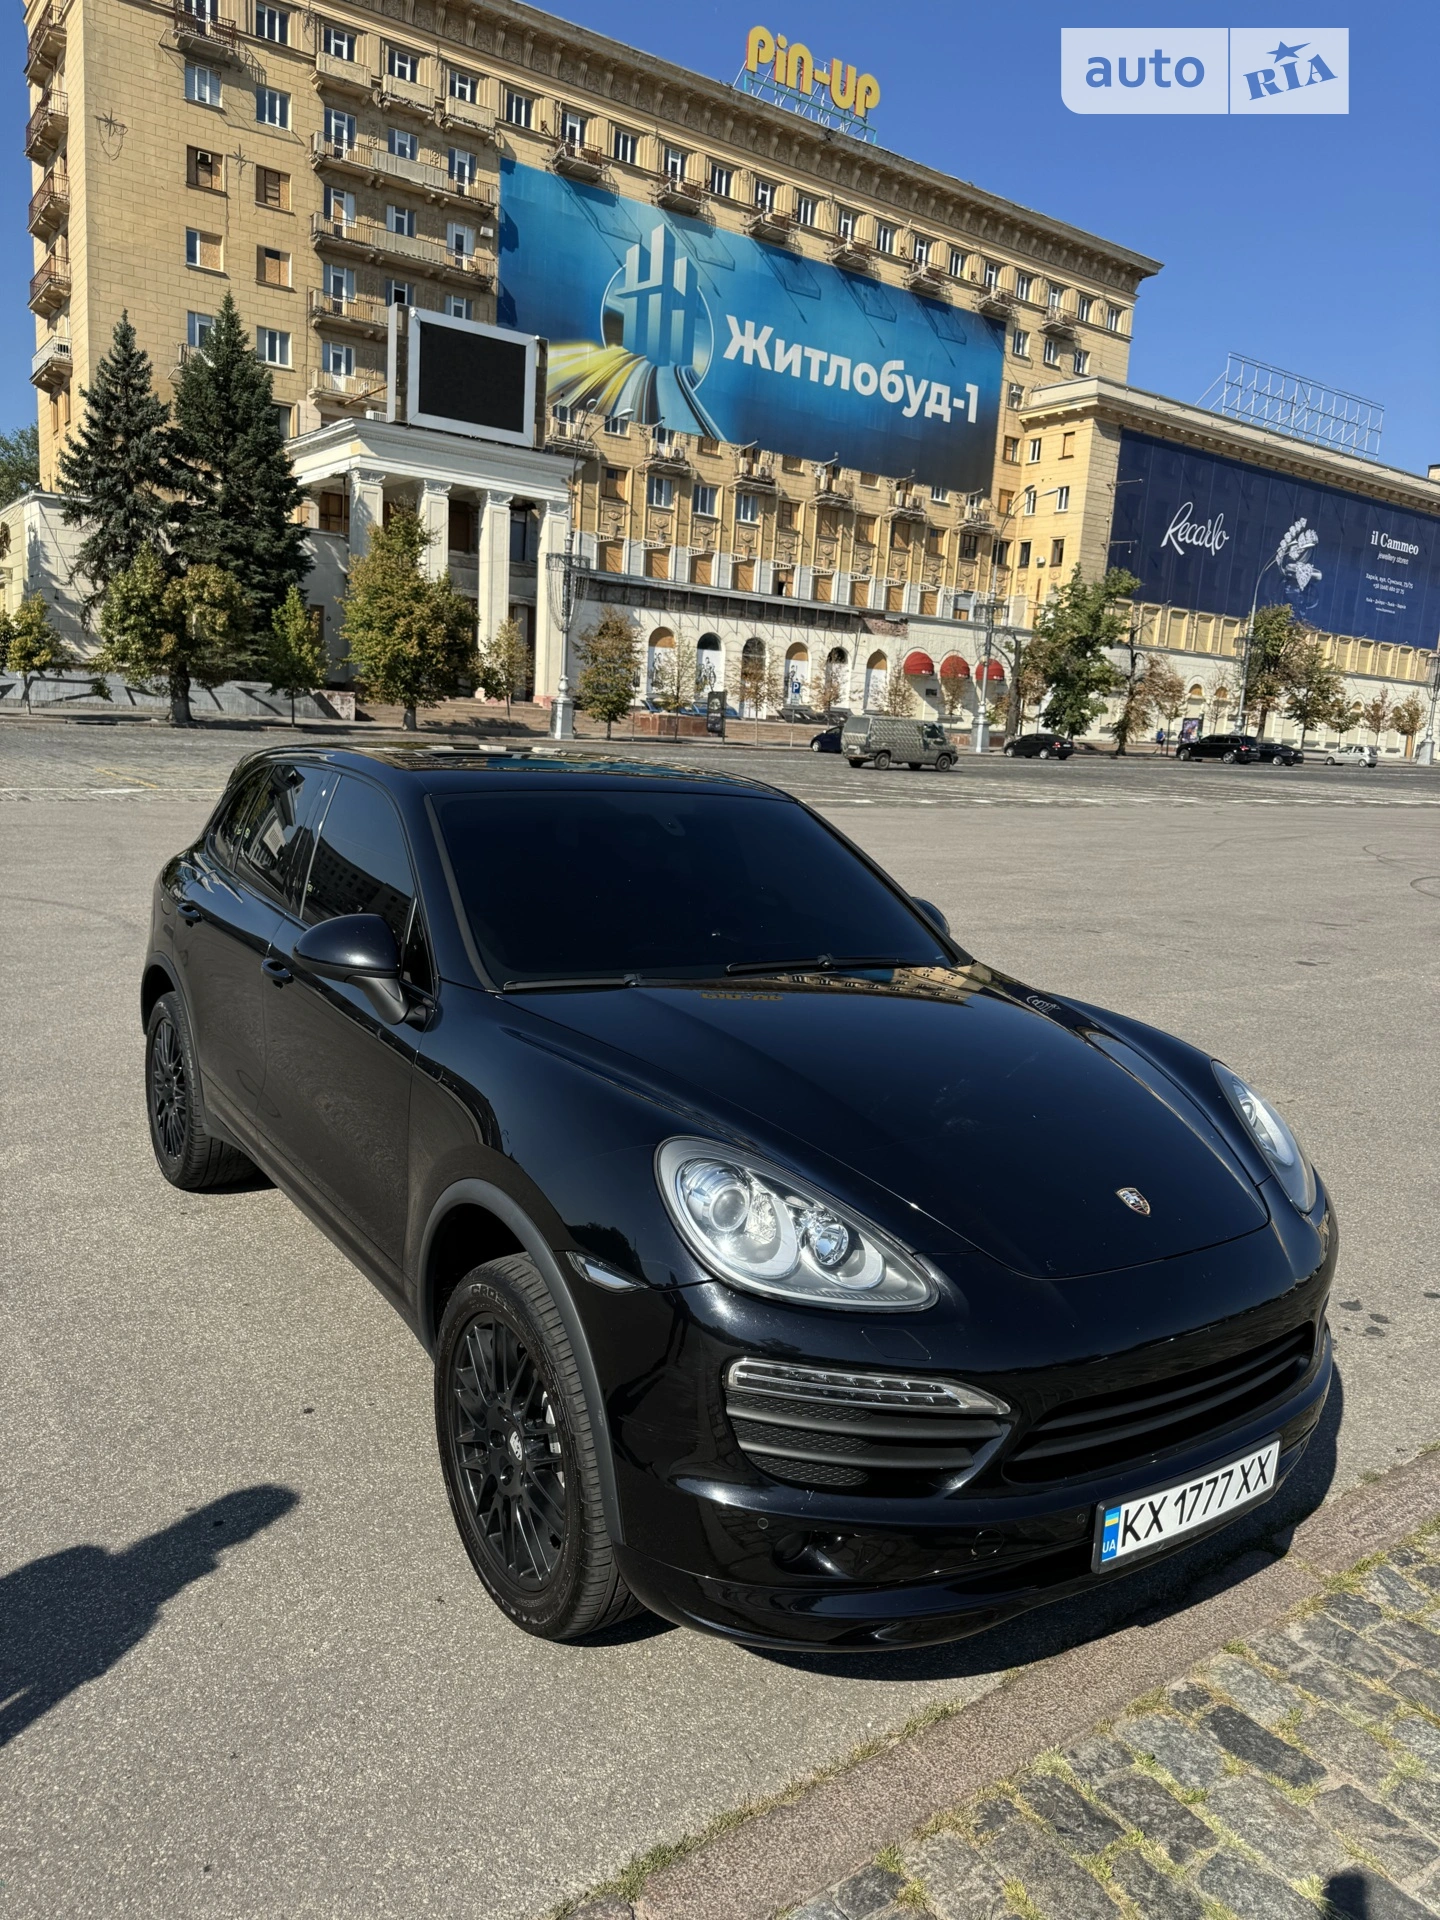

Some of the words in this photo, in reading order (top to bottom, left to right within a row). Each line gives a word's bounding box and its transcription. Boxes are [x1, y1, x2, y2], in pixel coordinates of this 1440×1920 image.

[722, 313, 979, 424] Житлобуд-1
[1160, 501, 1230, 557] Recarlo
[1370, 530, 1379, 546] il
[1380, 532, 1419, 556] Cammeo
[793, 682, 799, 693] P
[1121, 1494, 1169, 1548] KX
[1173, 1468, 1234, 1526] 1777
[1235, 1449, 1272, 1501] XX
[1102, 1538, 1116, 1553] UA
